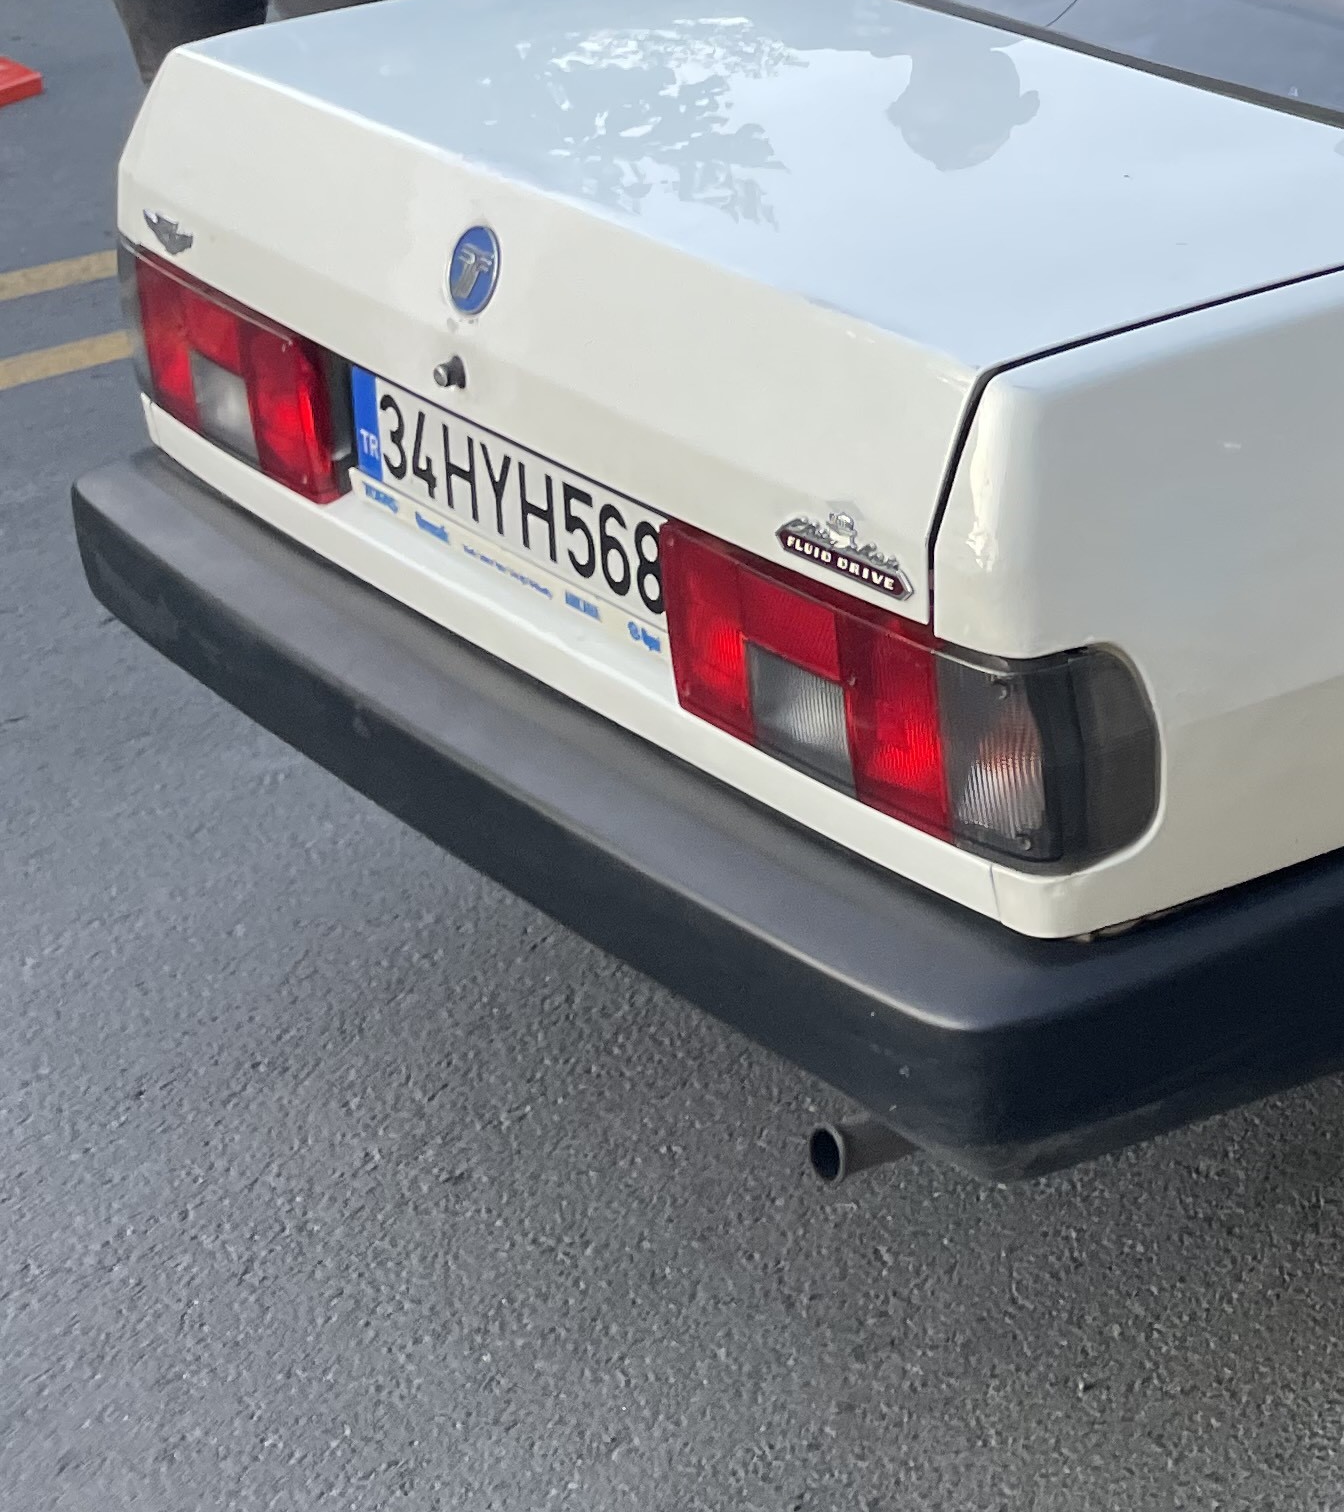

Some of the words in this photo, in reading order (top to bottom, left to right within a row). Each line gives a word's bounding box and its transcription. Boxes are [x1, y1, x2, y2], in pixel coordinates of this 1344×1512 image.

[359, 427, 380, 460] TR
[786, 535, 832, 564] FLUID
[836, 556, 895, 591] DRIVE
